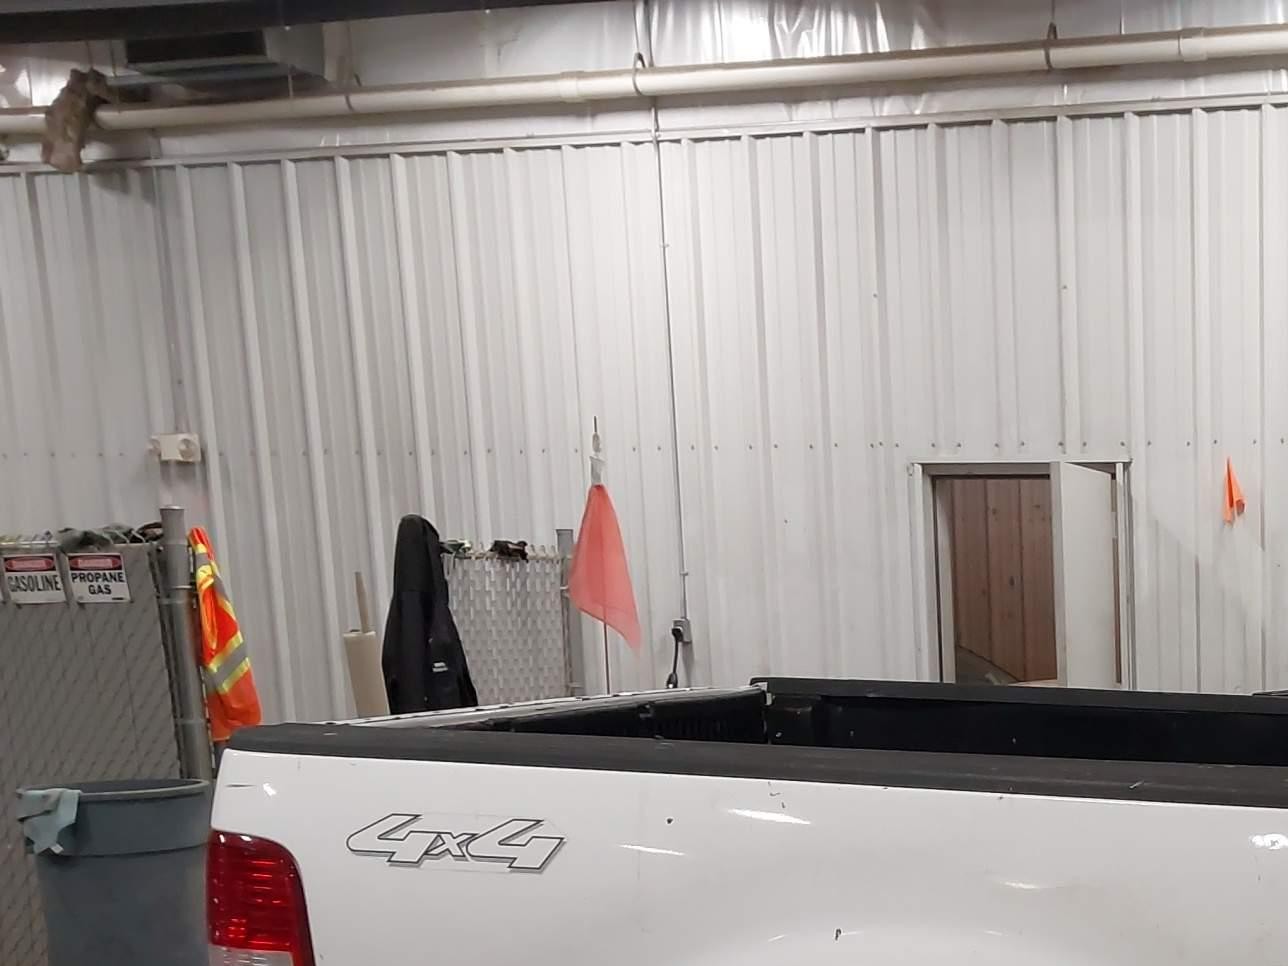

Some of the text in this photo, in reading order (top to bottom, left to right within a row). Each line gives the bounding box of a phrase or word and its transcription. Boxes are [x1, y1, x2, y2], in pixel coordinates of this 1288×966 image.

[7, 574, 61, 593] GASOLINE
[71, 571, 126, 583] PROPANE
[88, 584, 112, 595] GAS
[346, 813, 566, 874] 4x4
